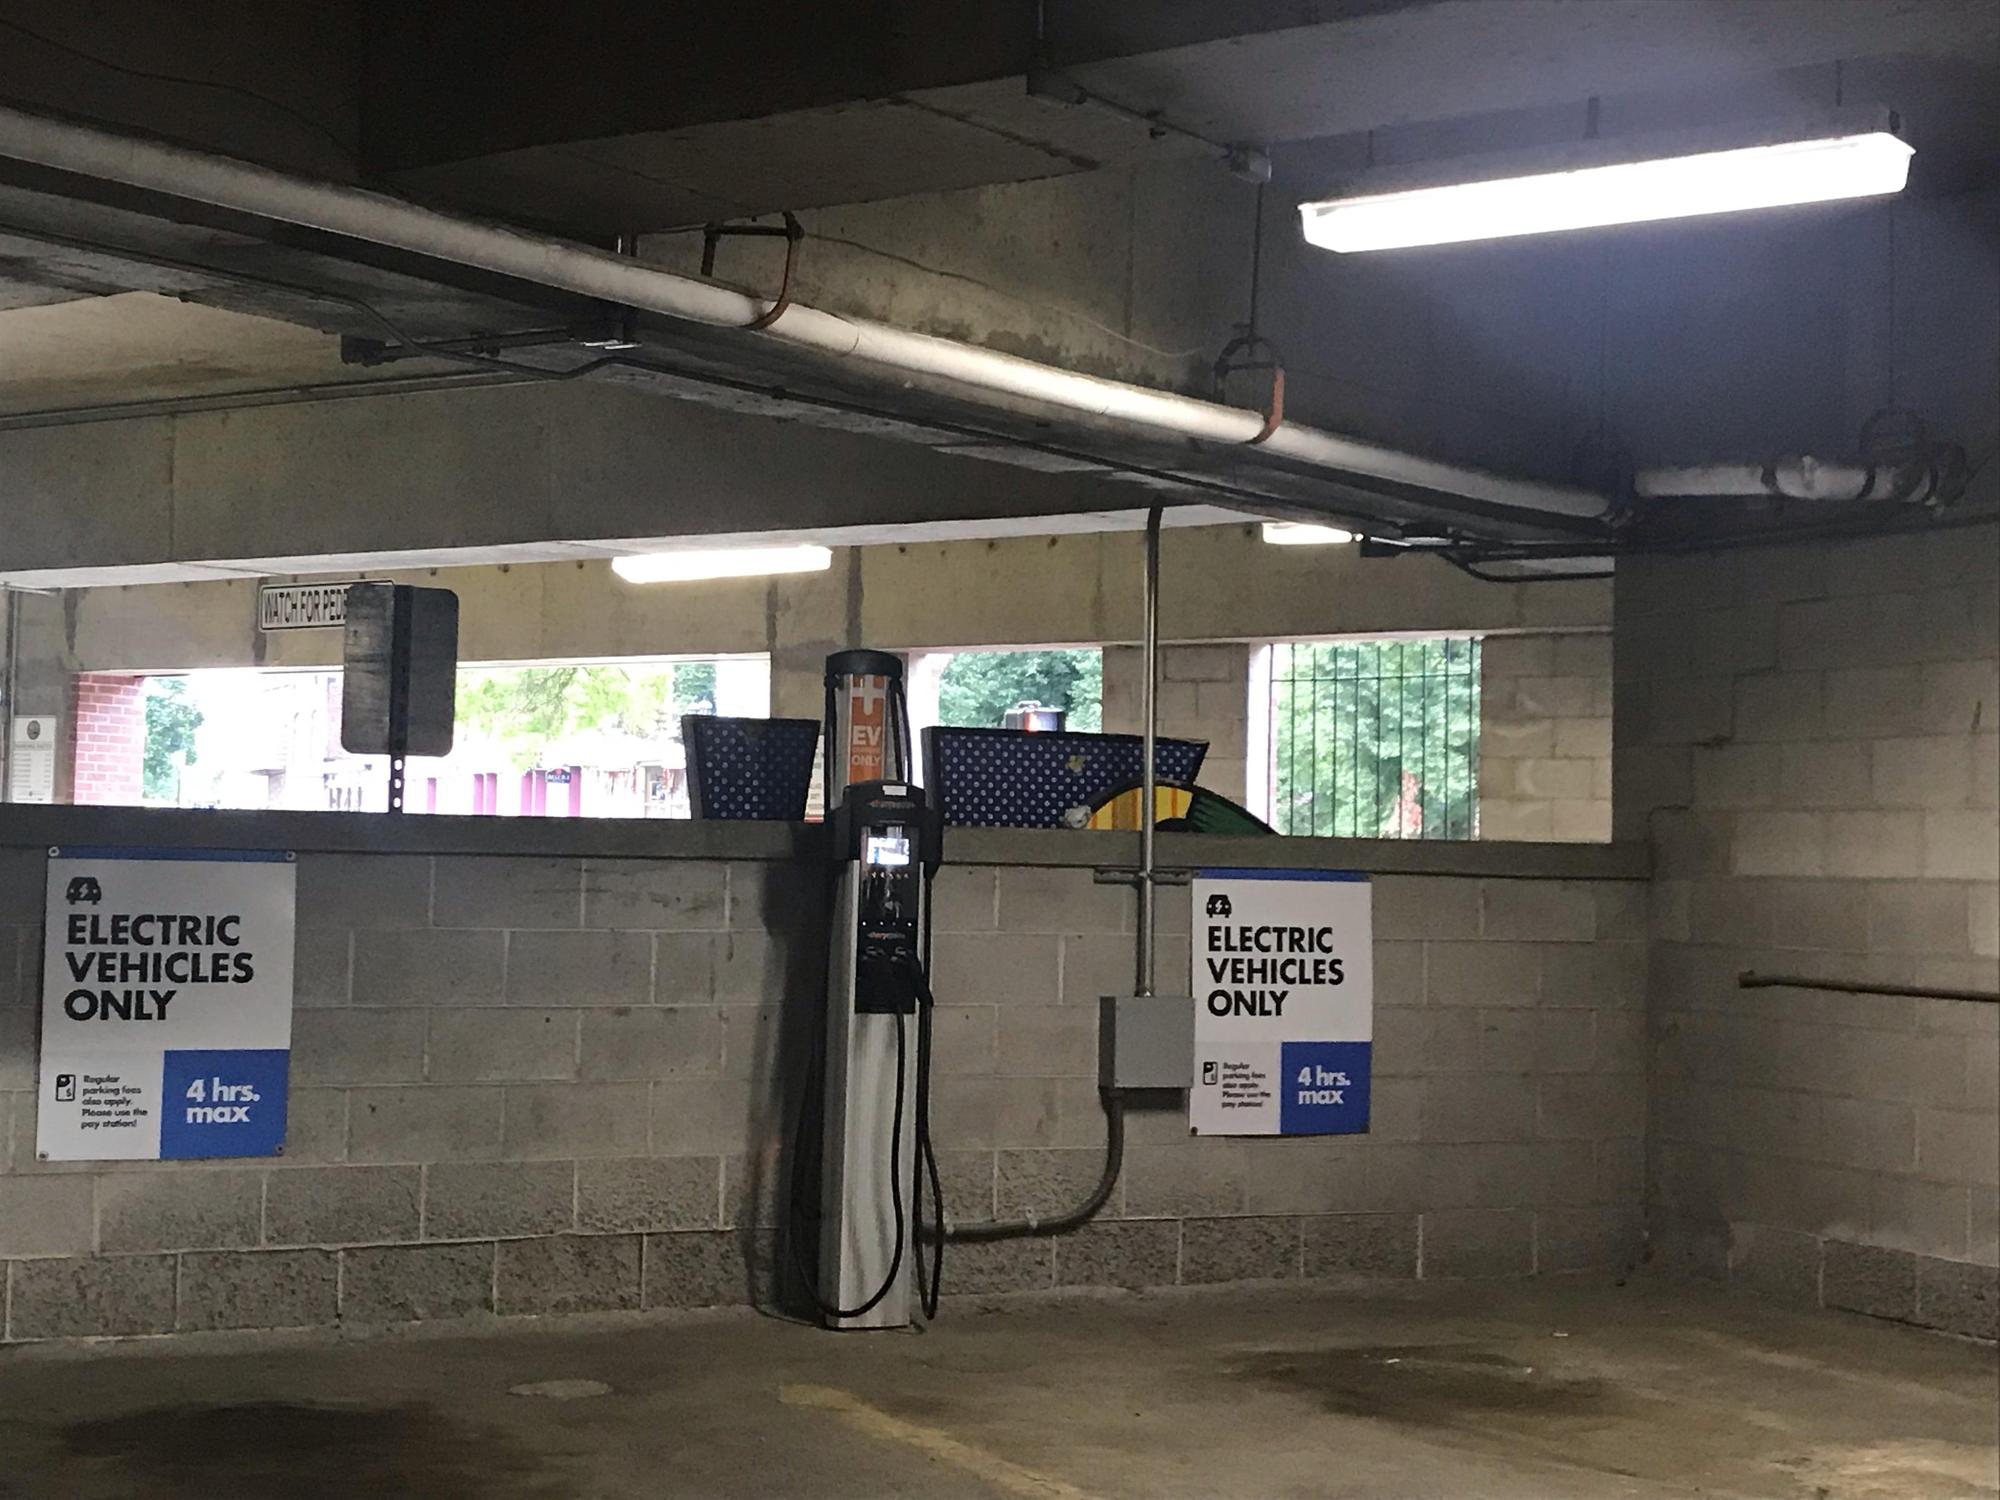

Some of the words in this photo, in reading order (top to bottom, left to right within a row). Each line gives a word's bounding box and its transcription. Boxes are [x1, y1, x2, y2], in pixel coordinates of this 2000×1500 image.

[301, 589, 320, 622] FOR
[853, 725, 881, 746] EV
[852, 754, 881, 766] ONLY
[67, 913, 241, 946] ELECTRIC
[1208, 926, 1333, 954] ELECTRIC
[65, 951, 254, 984] VEHICLES
[1206, 957, 1345, 985] VEHICLES
[64, 988, 177, 1021] ONLY
[1207, 989, 1289, 1017] ONLY
[83, 1074, 120, 1086] Regular
[1297, 1066, 1312, 1087] 4
[1315, 1064, 1351, 1087] hrs.
[82, 1086, 121, 1097] parking
[122, 1085, 142, 1095] fees
[186, 1079, 205, 1103] 4
[212, 1076, 261, 1102] hrs.
[1298, 1090, 1344, 1105] max
[82, 1096, 102, 1106] also
[82, 1108, 112, 1117] Please
[132, 1108, 148, 1116] the
[186, 1106, 250, 1124] max
[81, 1121, 100, 1130] pay
